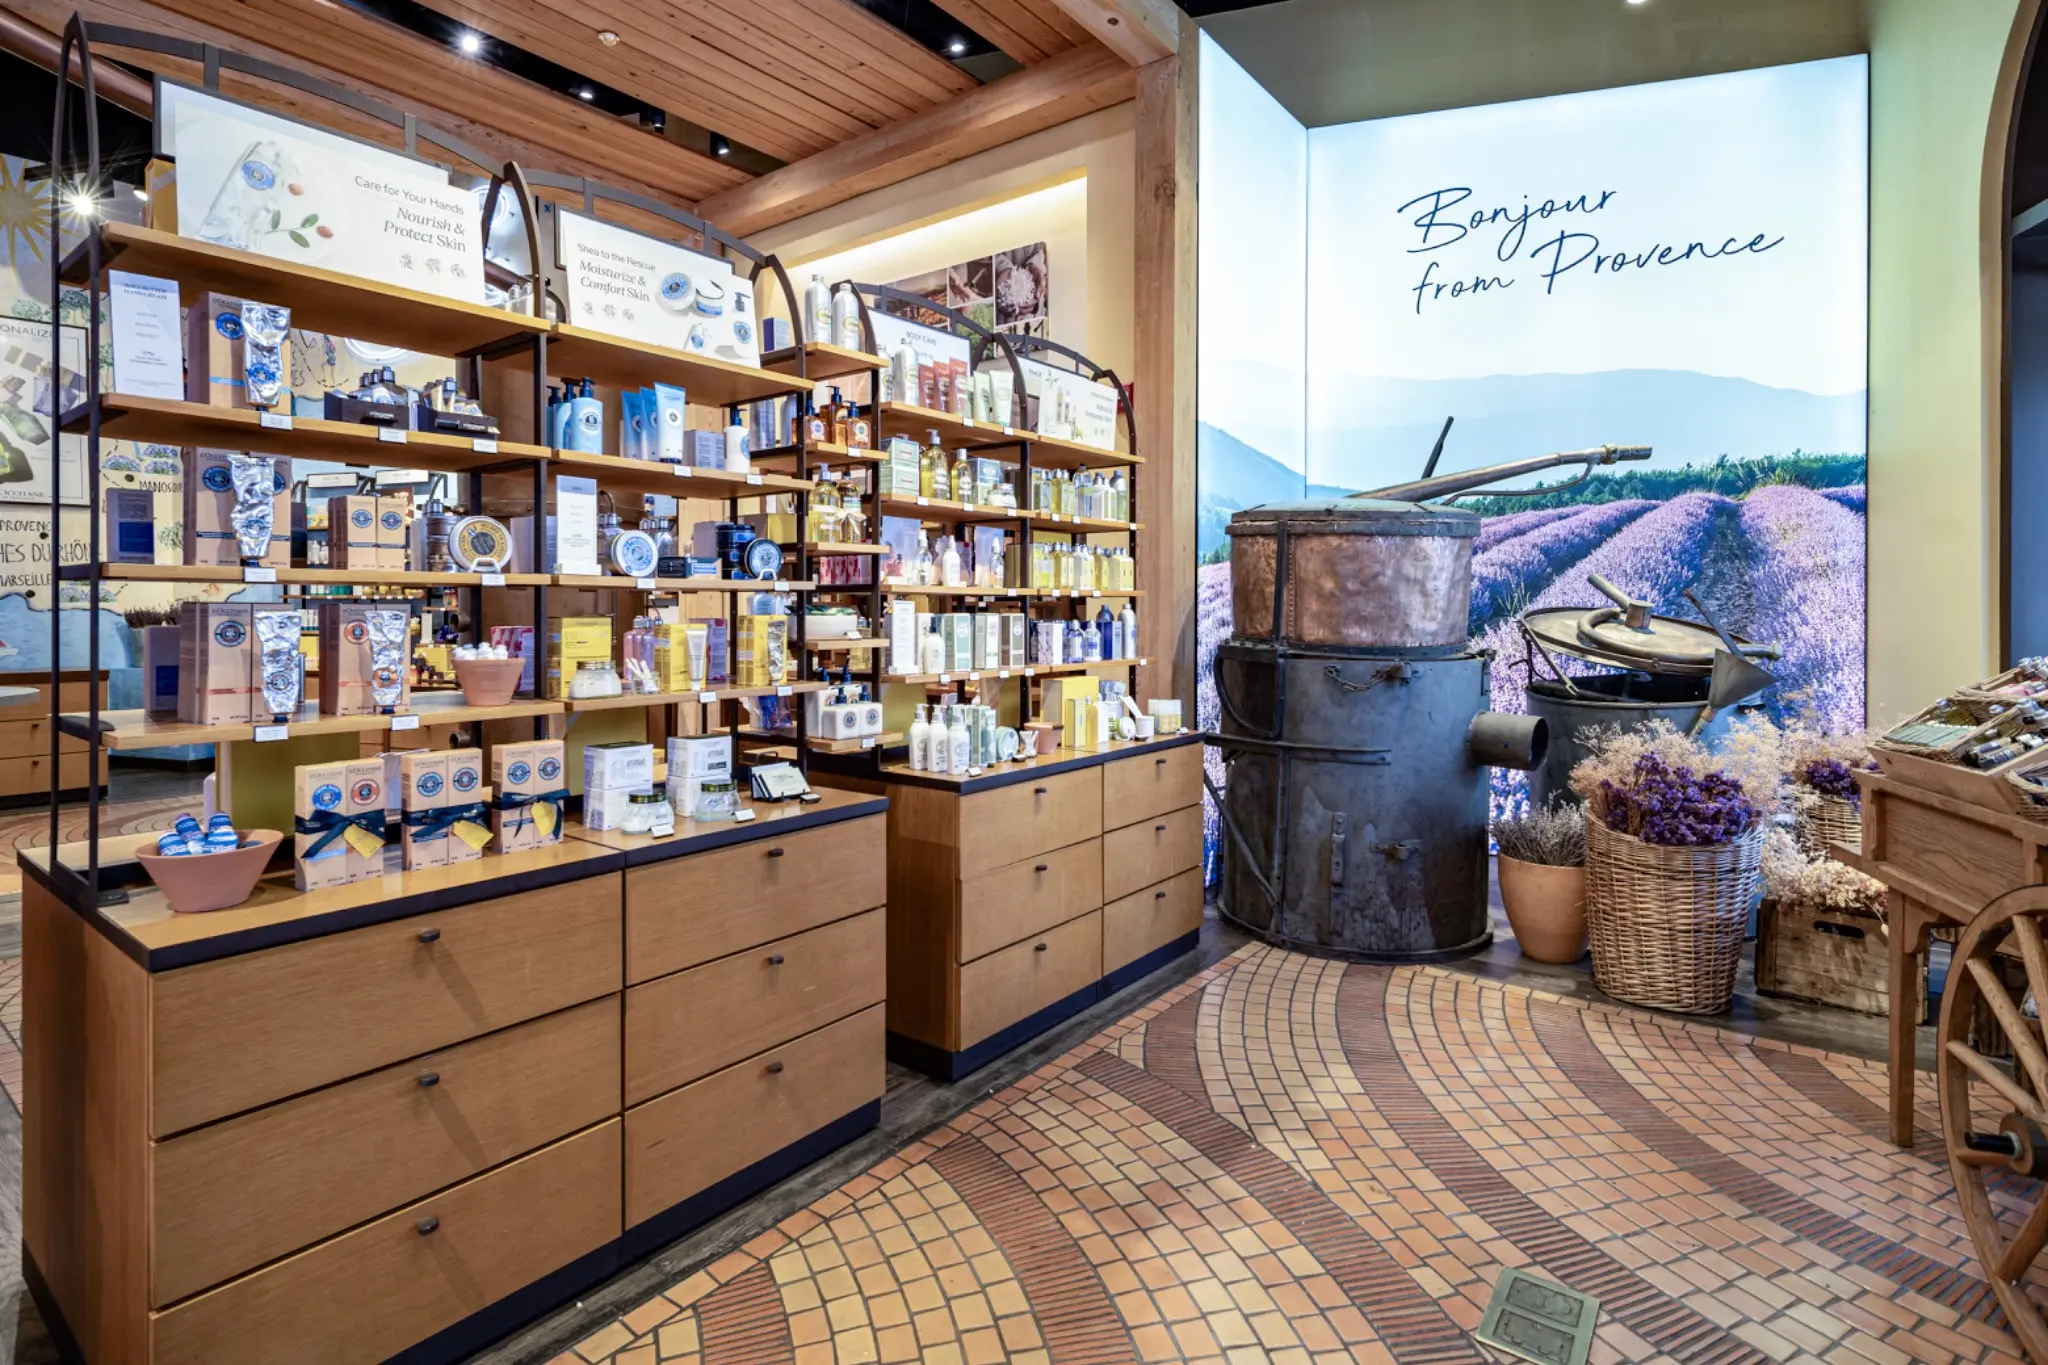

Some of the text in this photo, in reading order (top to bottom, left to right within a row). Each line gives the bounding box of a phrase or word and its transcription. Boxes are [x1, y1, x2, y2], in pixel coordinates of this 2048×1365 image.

[354, 175, 465, 216] Care for Your Hands
[384, 219, 466, 253] Protect Skin
[396, 206, 466, 236] Nourish &
[1397, 187, 1617, 262] Bonjour
[577, 242, 656, 272] Shea to the Rescue
[579, 259, 648, 287] Moisturize &
[1412, 230, 1785, 315] from Provence
[580, 276, 650, 303] Comfort Skin
[0, 324, 52, 338] ONALIZ
